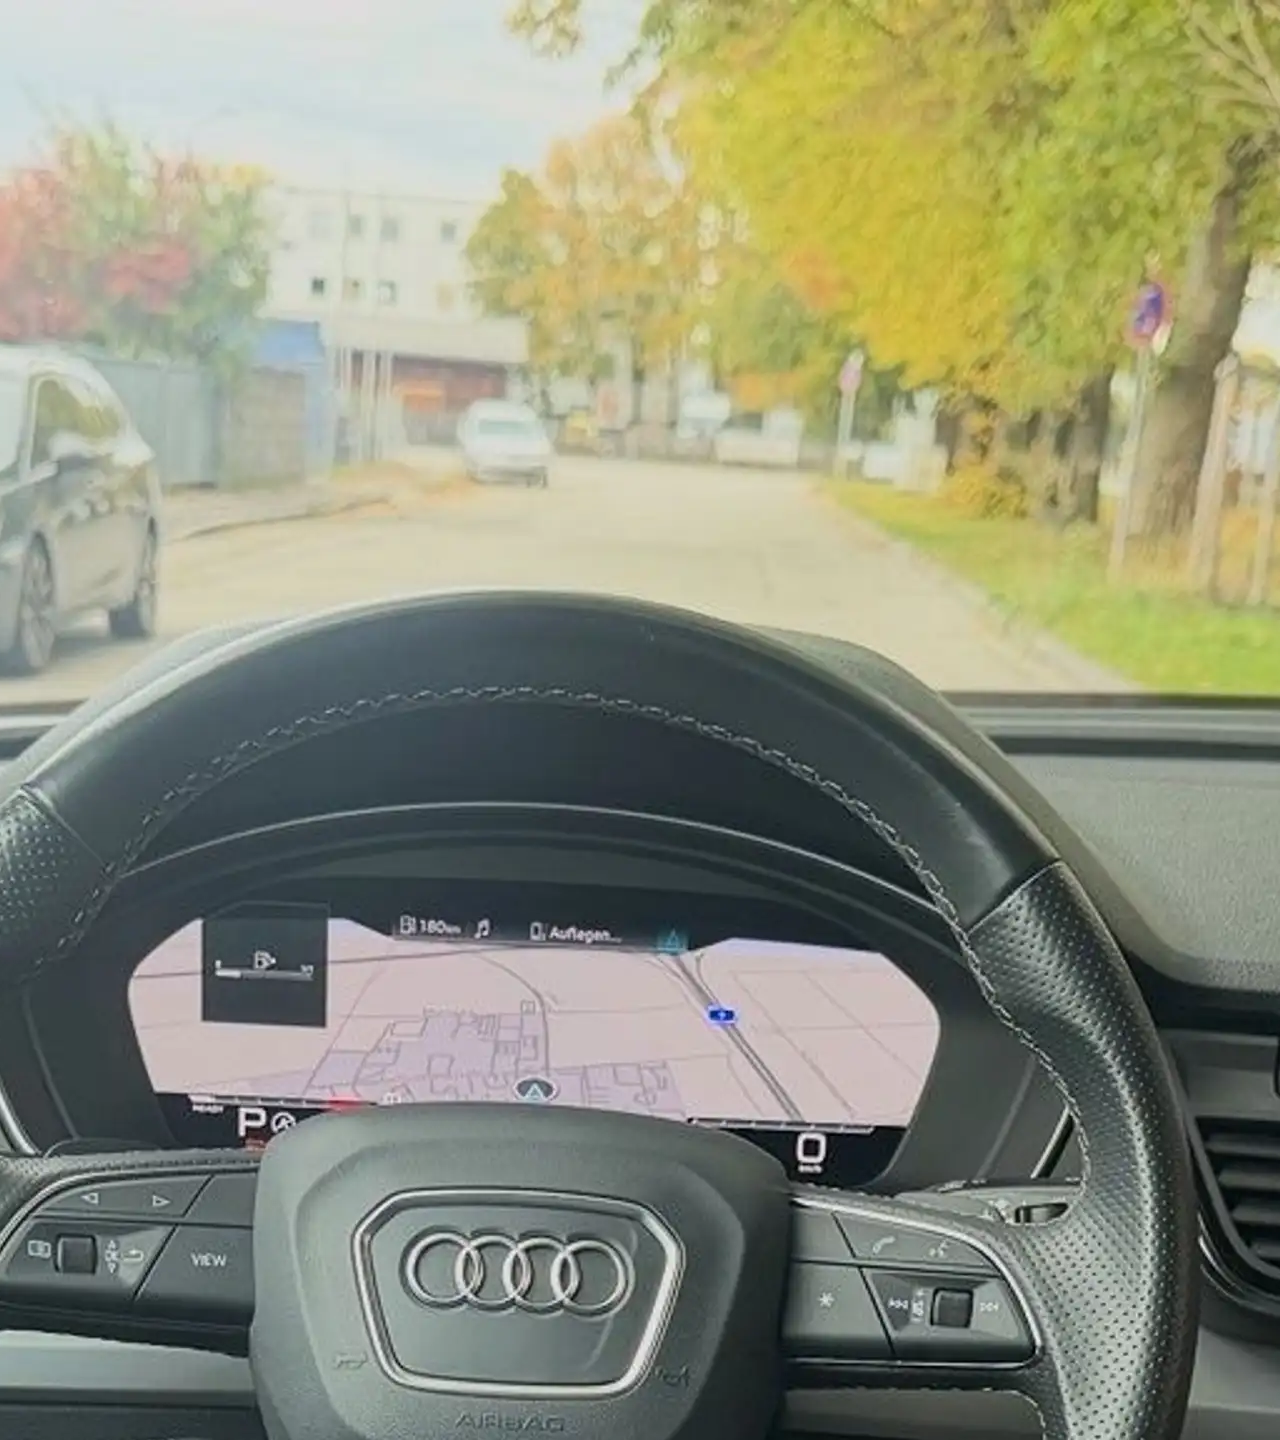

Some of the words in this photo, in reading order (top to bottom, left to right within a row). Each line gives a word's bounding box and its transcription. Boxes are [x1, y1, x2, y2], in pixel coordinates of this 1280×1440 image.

[238, 1107, 266, 1137] P
[796, 1132, 827, 1164] 0
[190, 1252, 227, 1267] VIEW
[455, 1411, 565, 1433] AIRBAG
